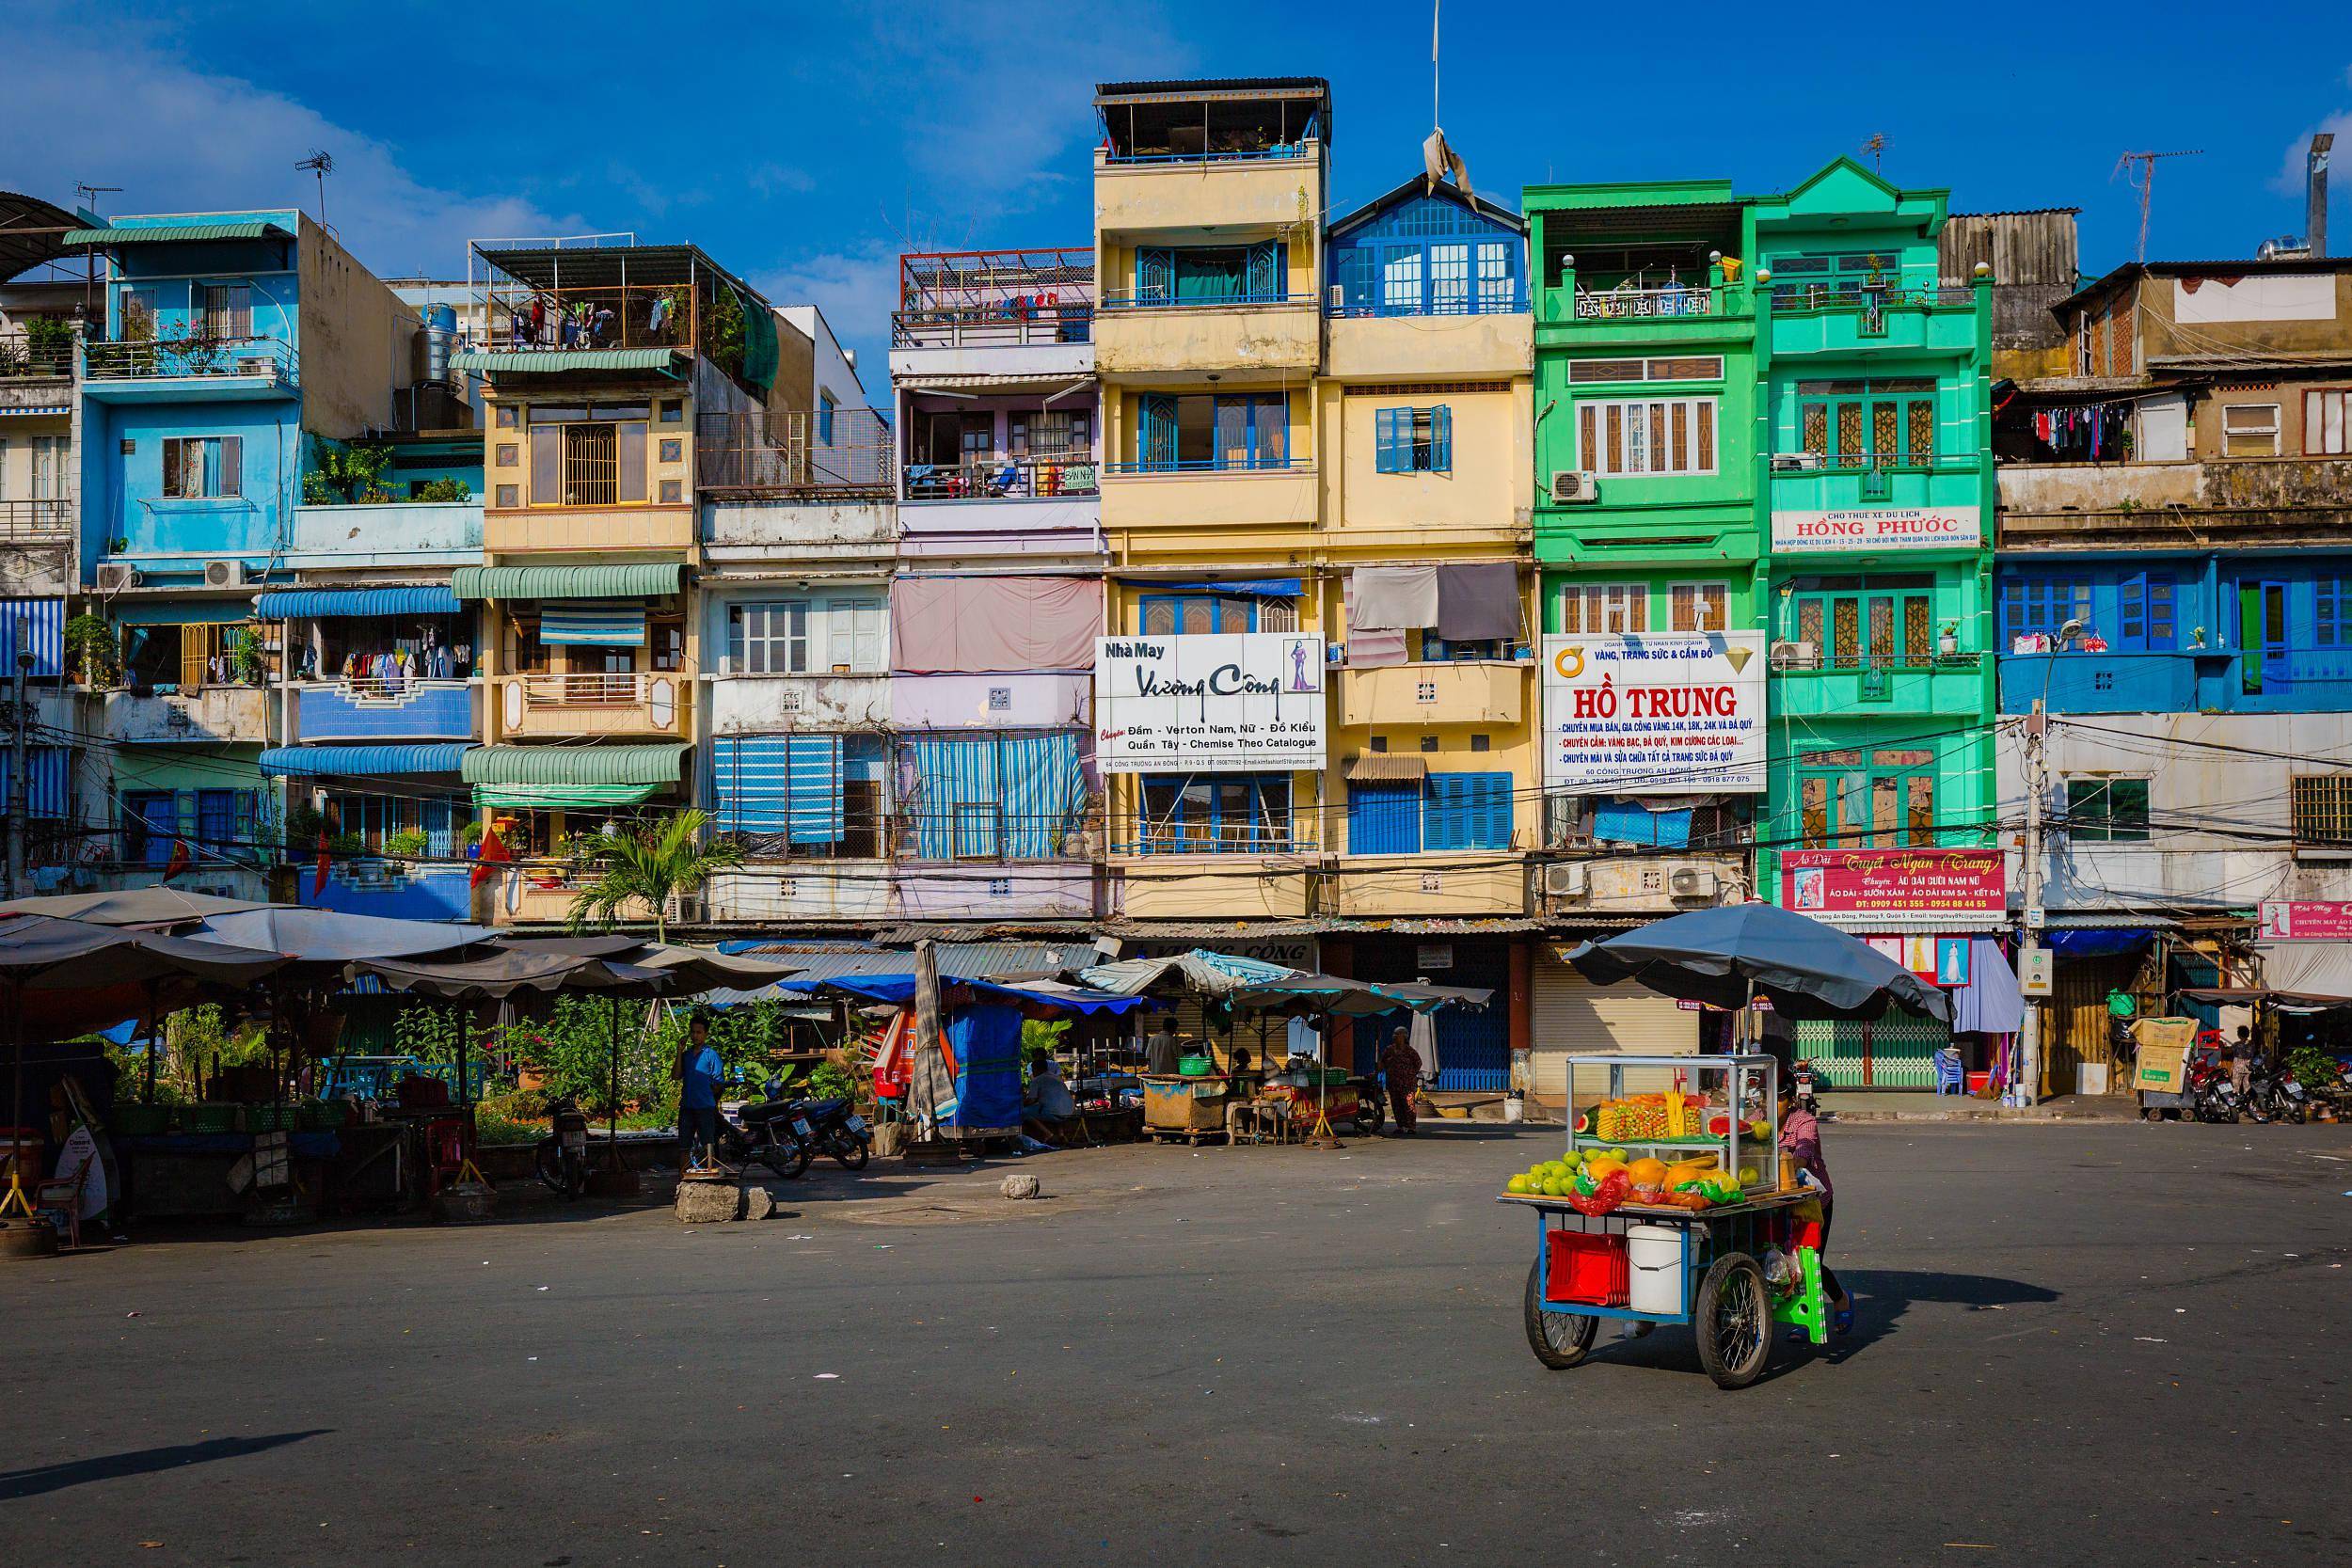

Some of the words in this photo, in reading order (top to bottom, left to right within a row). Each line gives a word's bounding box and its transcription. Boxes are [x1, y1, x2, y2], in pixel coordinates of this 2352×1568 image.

[1797, 518, 1865, 536] HỒNG
[1877, 515, 1958, 534] PHƯỚC
[1105, 643, 1132, 657] Nhà
[1135, 643, 1166, 659] May
[1595, 649, 1619, 661] VÀNG,
[1621, 650, 1649, 660] TRANG
[1651, 647, 1669, 659] SỨC
[1671, 650, 1677, 659] &
[1208, 663, 1280, 722] Công
[1573, 673, 1617, 718] HỒ
[1626, 687, 1738, 718] TRUNG
[1166, 725, 1205, 735] Verton
[1209, 724, 1237, 735] Nam,
[1240, 723, 1256, 734] Nữ
[1270, 721, 1287, 733] Đồ
[1291, 721, 1317, 733] Kiểu
[1563, 721, 1588, 733] CHUYÊN
[1590, 723, 1604, 733] MUA
[1605, 721, 1621, 734] BÁN,
[1622, 722, 1632, 732] GIA
[1634, 721, 1651, 732] CÔNG
[1653, 721, 1670, 731] VÀNG
[1672, 721, 1687, 732] 14K,
[1704, 721, 1717, 730] 24K
[1718, 719, 1727, 730] VÀ
[1728, 719, 1738, 729] ĐÁ
[1128, 738, 1155, 751] Quần
[1162, 740, 1180, 751] Tây
[1190, 739, 1234, 749] Chemise
[1238, 738, 1263, 749] Theo
[1266, 737, 1317, 750] Catalogue
[1563, 736, 1589, 748] CHUYÊN
[1608, 736, 1625, 747] VÀNG
[1644, 736, 1652, 747] ĐÁ
[1670, 736, 1683, 746] KIM
[1563, 752, 1589, 763] CHUYÊN
[1603, 752, 1613, 762] VÀ
[1672, 752, 1693, 762] TRANG
[1709, 750, 1718, 761] ĐÁ
[1890, 853, 1933, 875] Ngân
[1941, 853, 2000, 876] (Trang)
[1898, 876, 1908, 885] ÁO
[1947, 877, 1966, 885] NAM
[1829, 888, 1841, 896] ÁO
[1843, 888, 1857, 896] DÀI
[1912, 887, 1924, 896] ÁO
[1246, 942, 1307, 959] CÔNG
